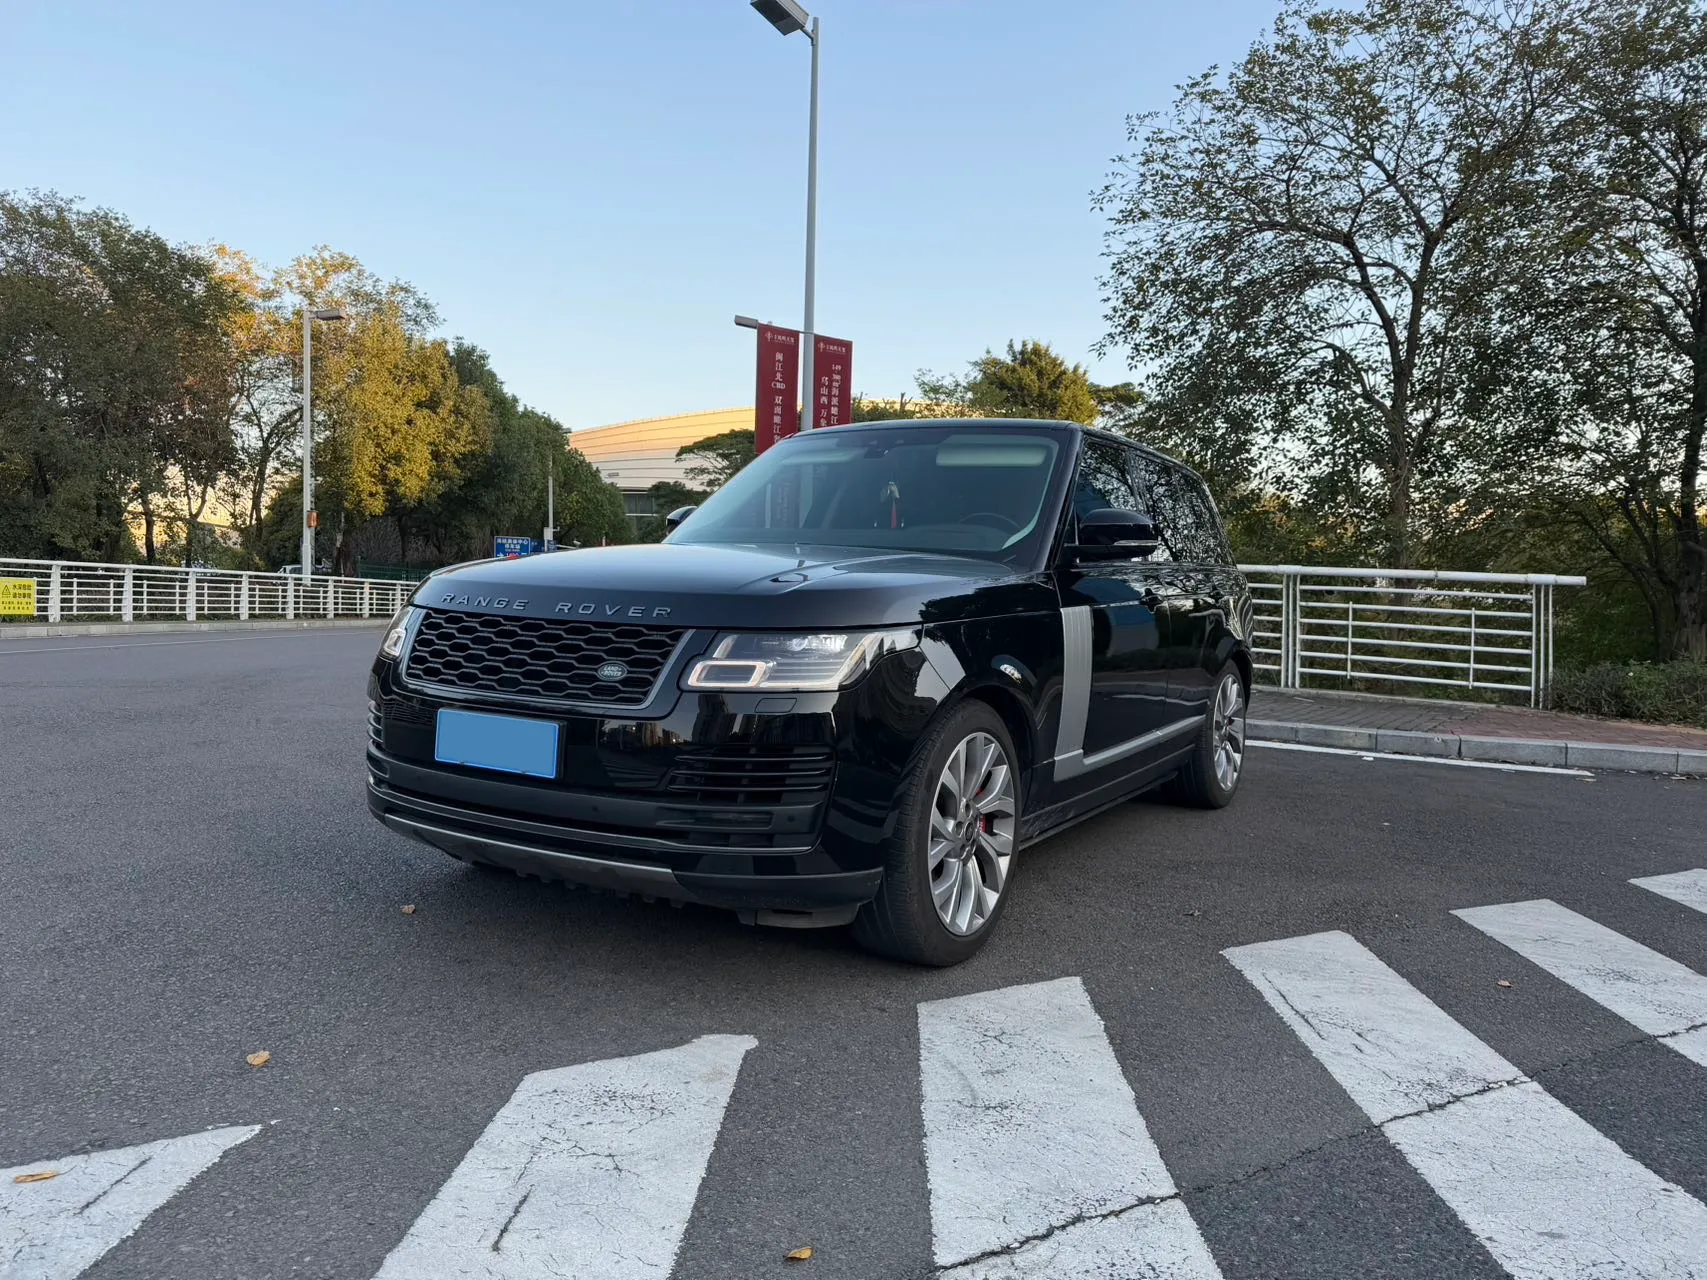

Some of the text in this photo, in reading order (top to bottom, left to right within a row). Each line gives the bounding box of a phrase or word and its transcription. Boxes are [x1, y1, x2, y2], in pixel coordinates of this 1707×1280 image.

[771, 352, 786, 389] 闽江北CBD
[440, 593, 672, 618] RANGE ROVER
[603, 664, 619, 672] LAND
